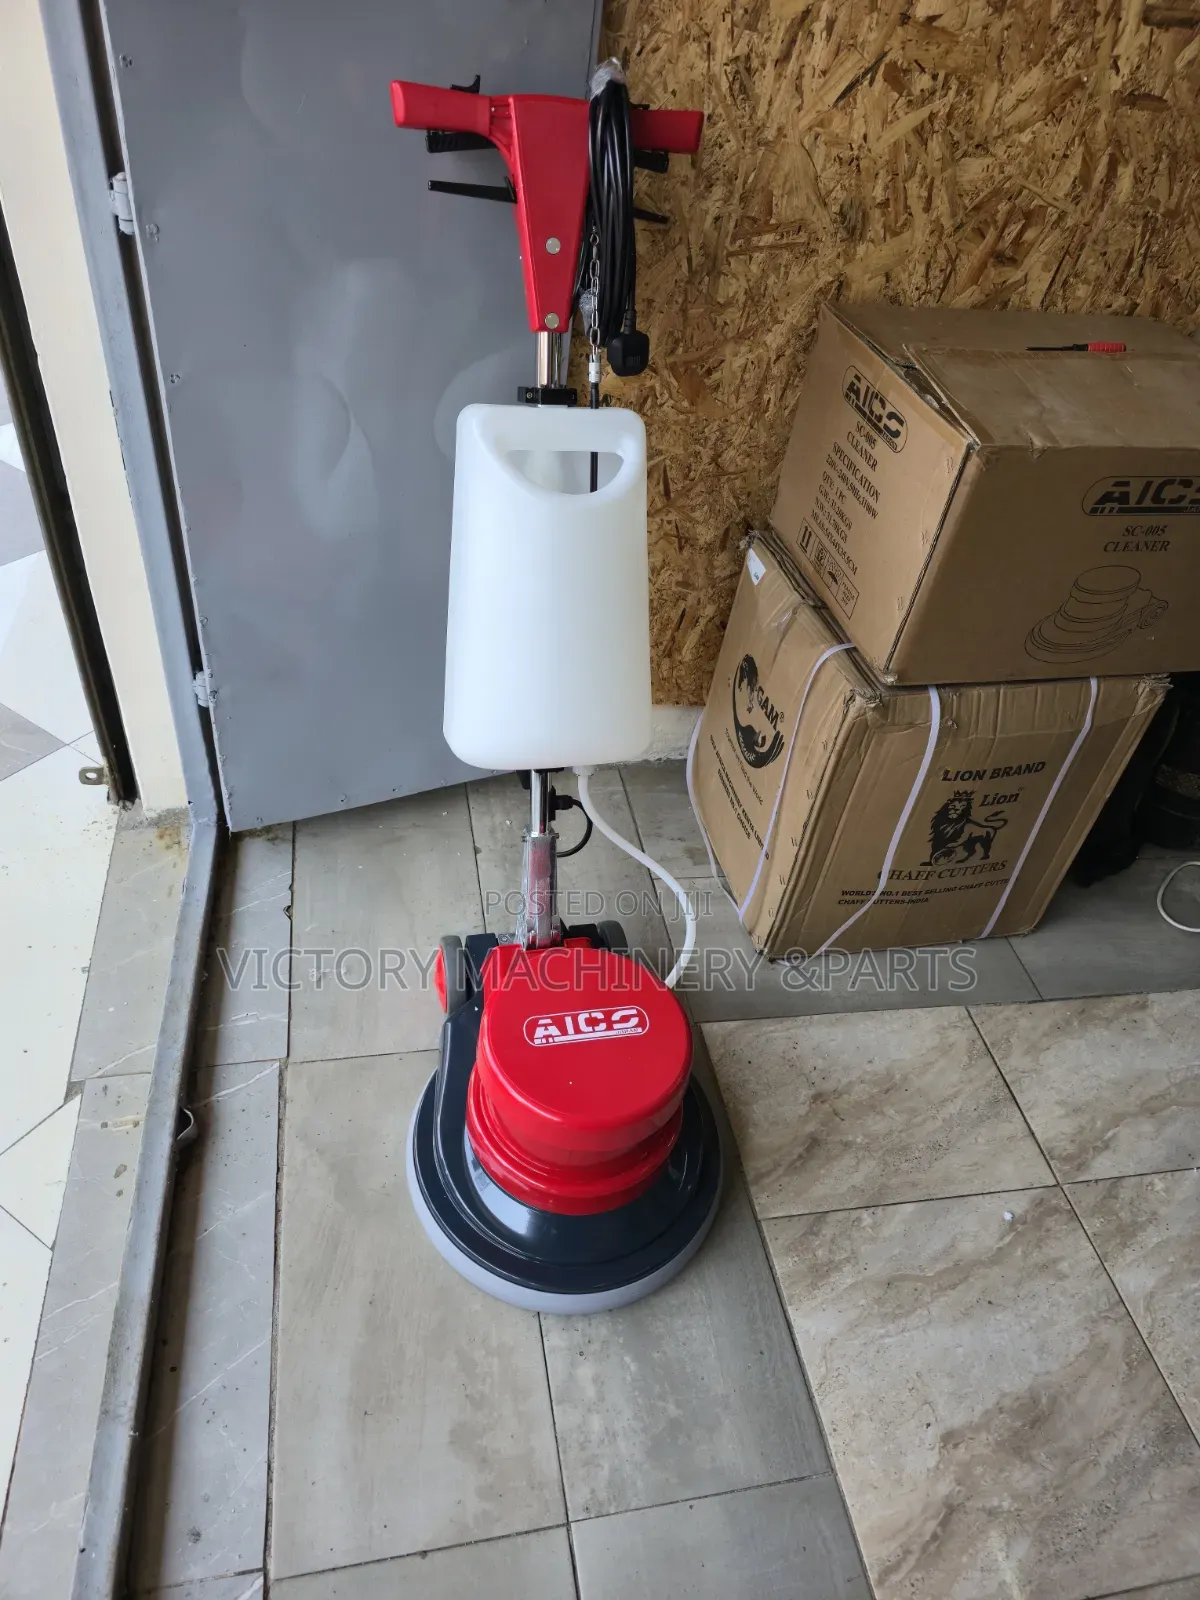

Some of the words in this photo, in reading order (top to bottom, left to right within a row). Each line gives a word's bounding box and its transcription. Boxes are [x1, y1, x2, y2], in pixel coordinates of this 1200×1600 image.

[845, 373, 905, 438] AICS
[846, 431, 878, 473] CLEANER
[832, 441, 880, 504] SPECIFICATION
[1092, 478, 1200, 507] AIC
[1121, 524, 1168, 537] SC-005
[1103, 540, 1171, 553] CLEANER
[941, 769, 987, 782] LION
[989, 761, 1046, 780] BRAND
[979, 792, 1020, 808] Lion
[938, 860, 1008, 879] CUTTERS
[923, 886, 958, 895] SELLING
[958, 882, 984, 891] CHAFF
[870, 897, 929, 905] UTTERS-INDIA
[533, 1008, 640, 1045] AICS
